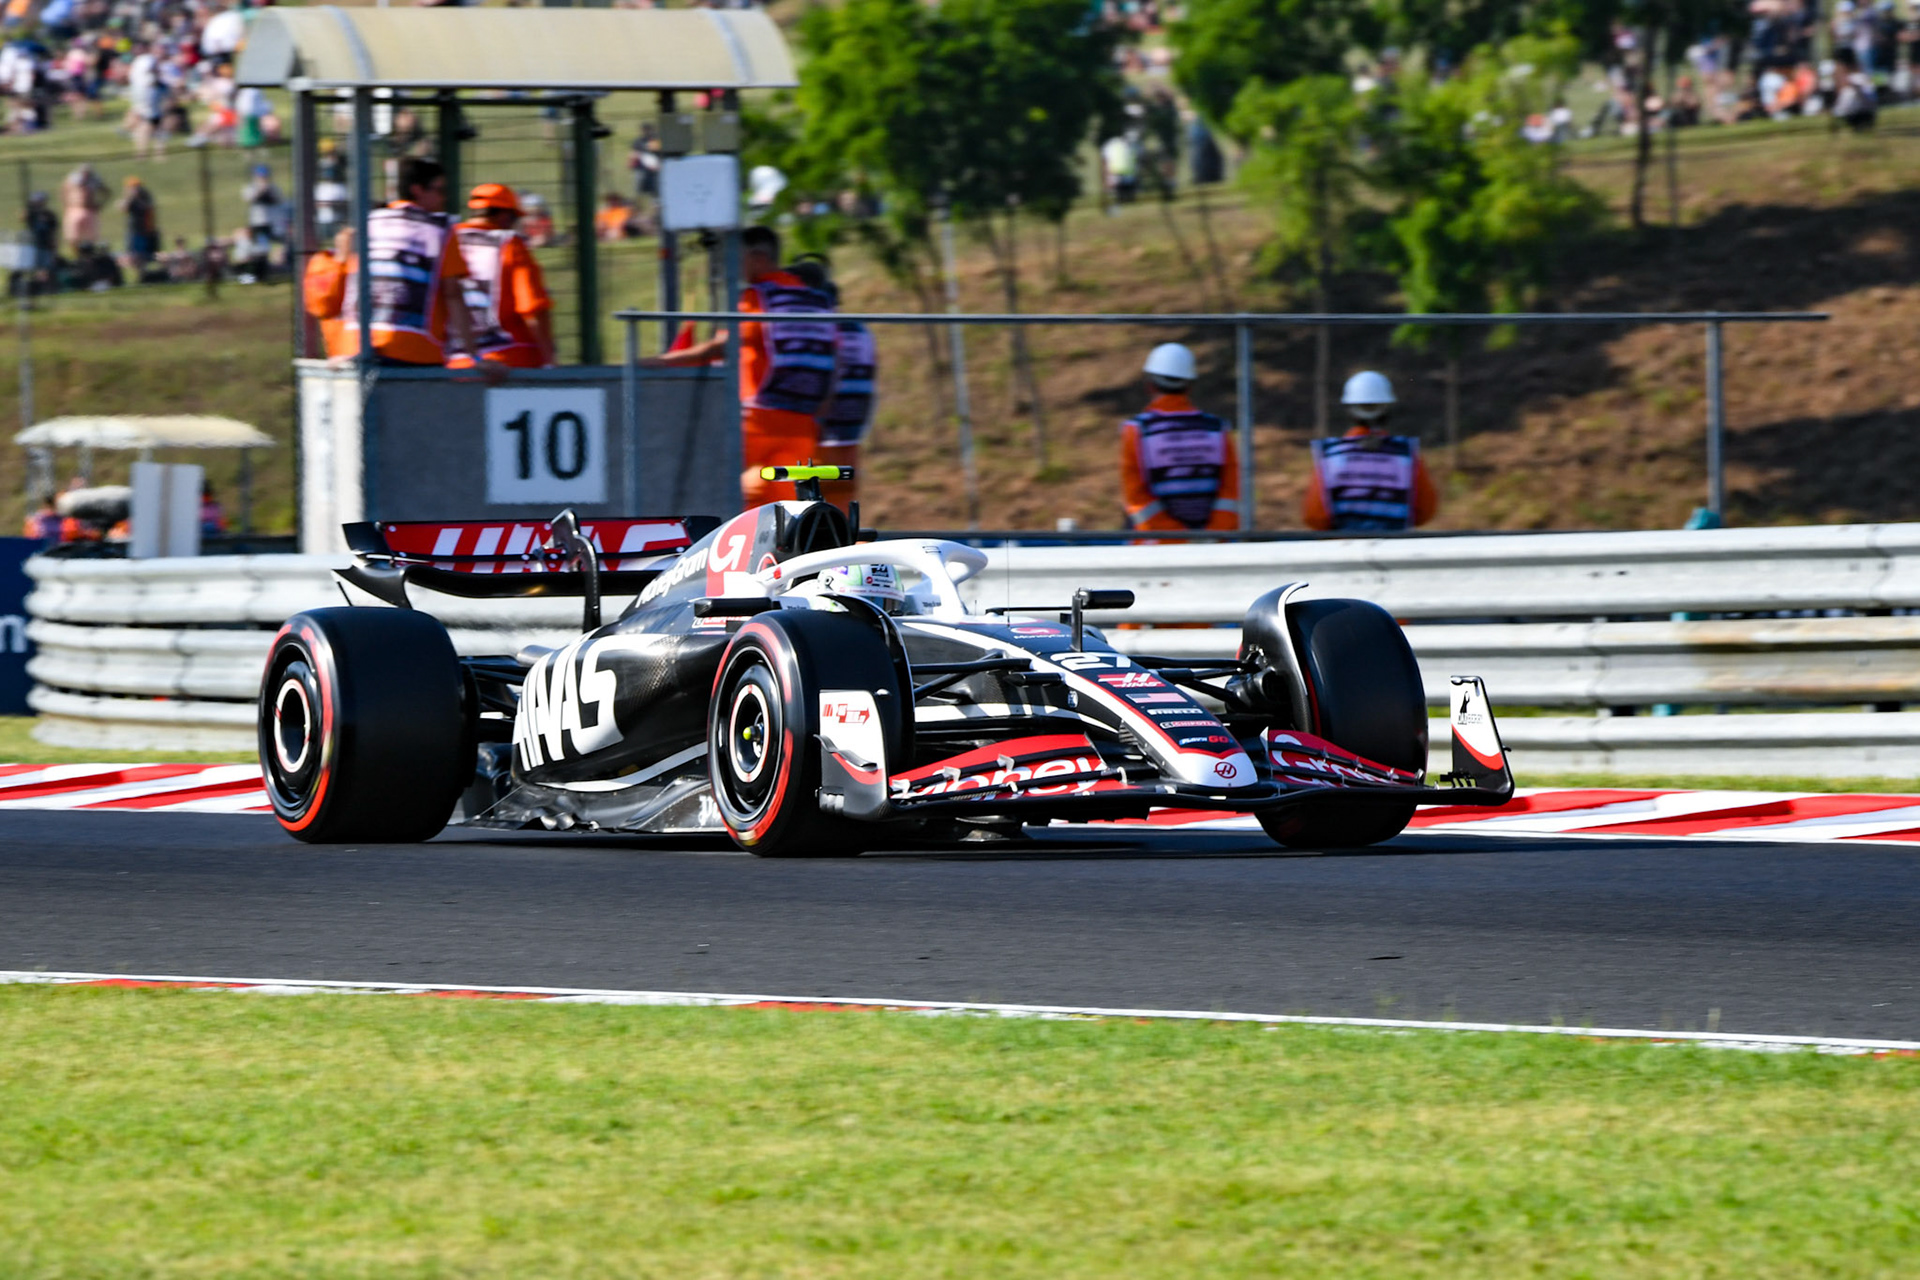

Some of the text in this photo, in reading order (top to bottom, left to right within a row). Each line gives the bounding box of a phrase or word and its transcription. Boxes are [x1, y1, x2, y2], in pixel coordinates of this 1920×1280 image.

[503, 409, 589, 481] 10
[1050, 652, 1132, 671] 27
[512, 625, 674, 772] HAAS
